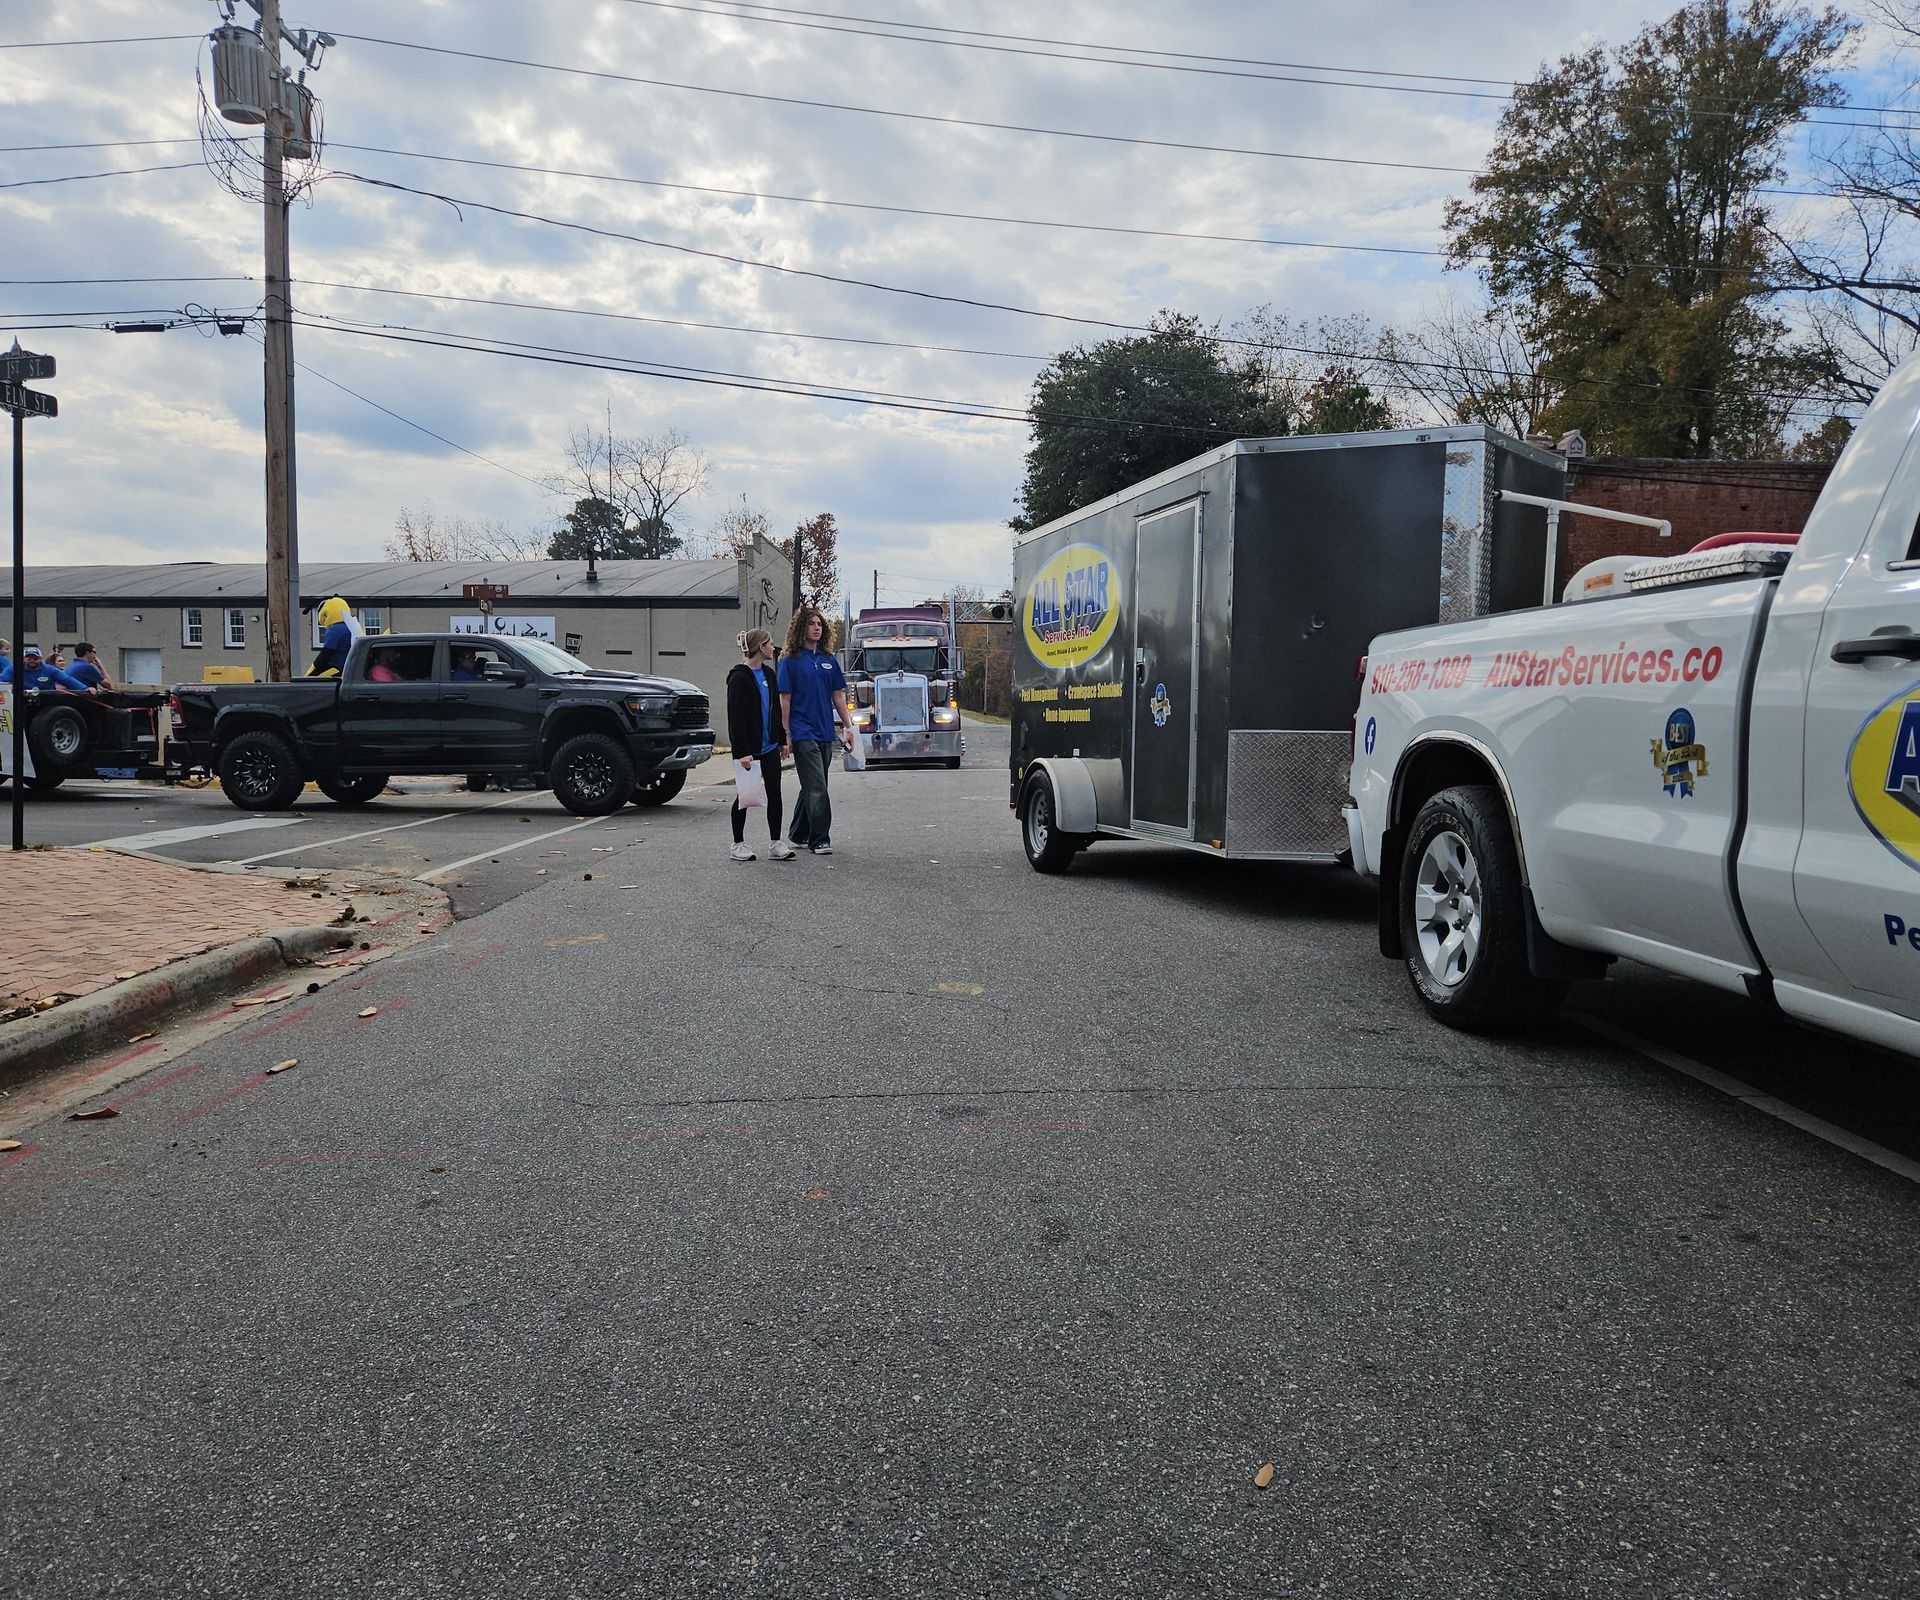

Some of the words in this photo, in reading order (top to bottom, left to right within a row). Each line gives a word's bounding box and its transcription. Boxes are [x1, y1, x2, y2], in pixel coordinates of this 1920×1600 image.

[6, 360, 20, 379] 1ST
[28, 358, 44, 377] ST.
[5, 384, 27, 408] ELM
[34, 393, 49, 413] ST.
[1031, 577, 1061, 628] ALL
[1063, 560, 1110, 621] STAR
[1044, 627, 1076, 645] Services
[1483, 640, 1723, 689] AllStarServices.co
[1098, 681, 1123, 698] Solutions
[1669, 723, 1691, 744] BEST
